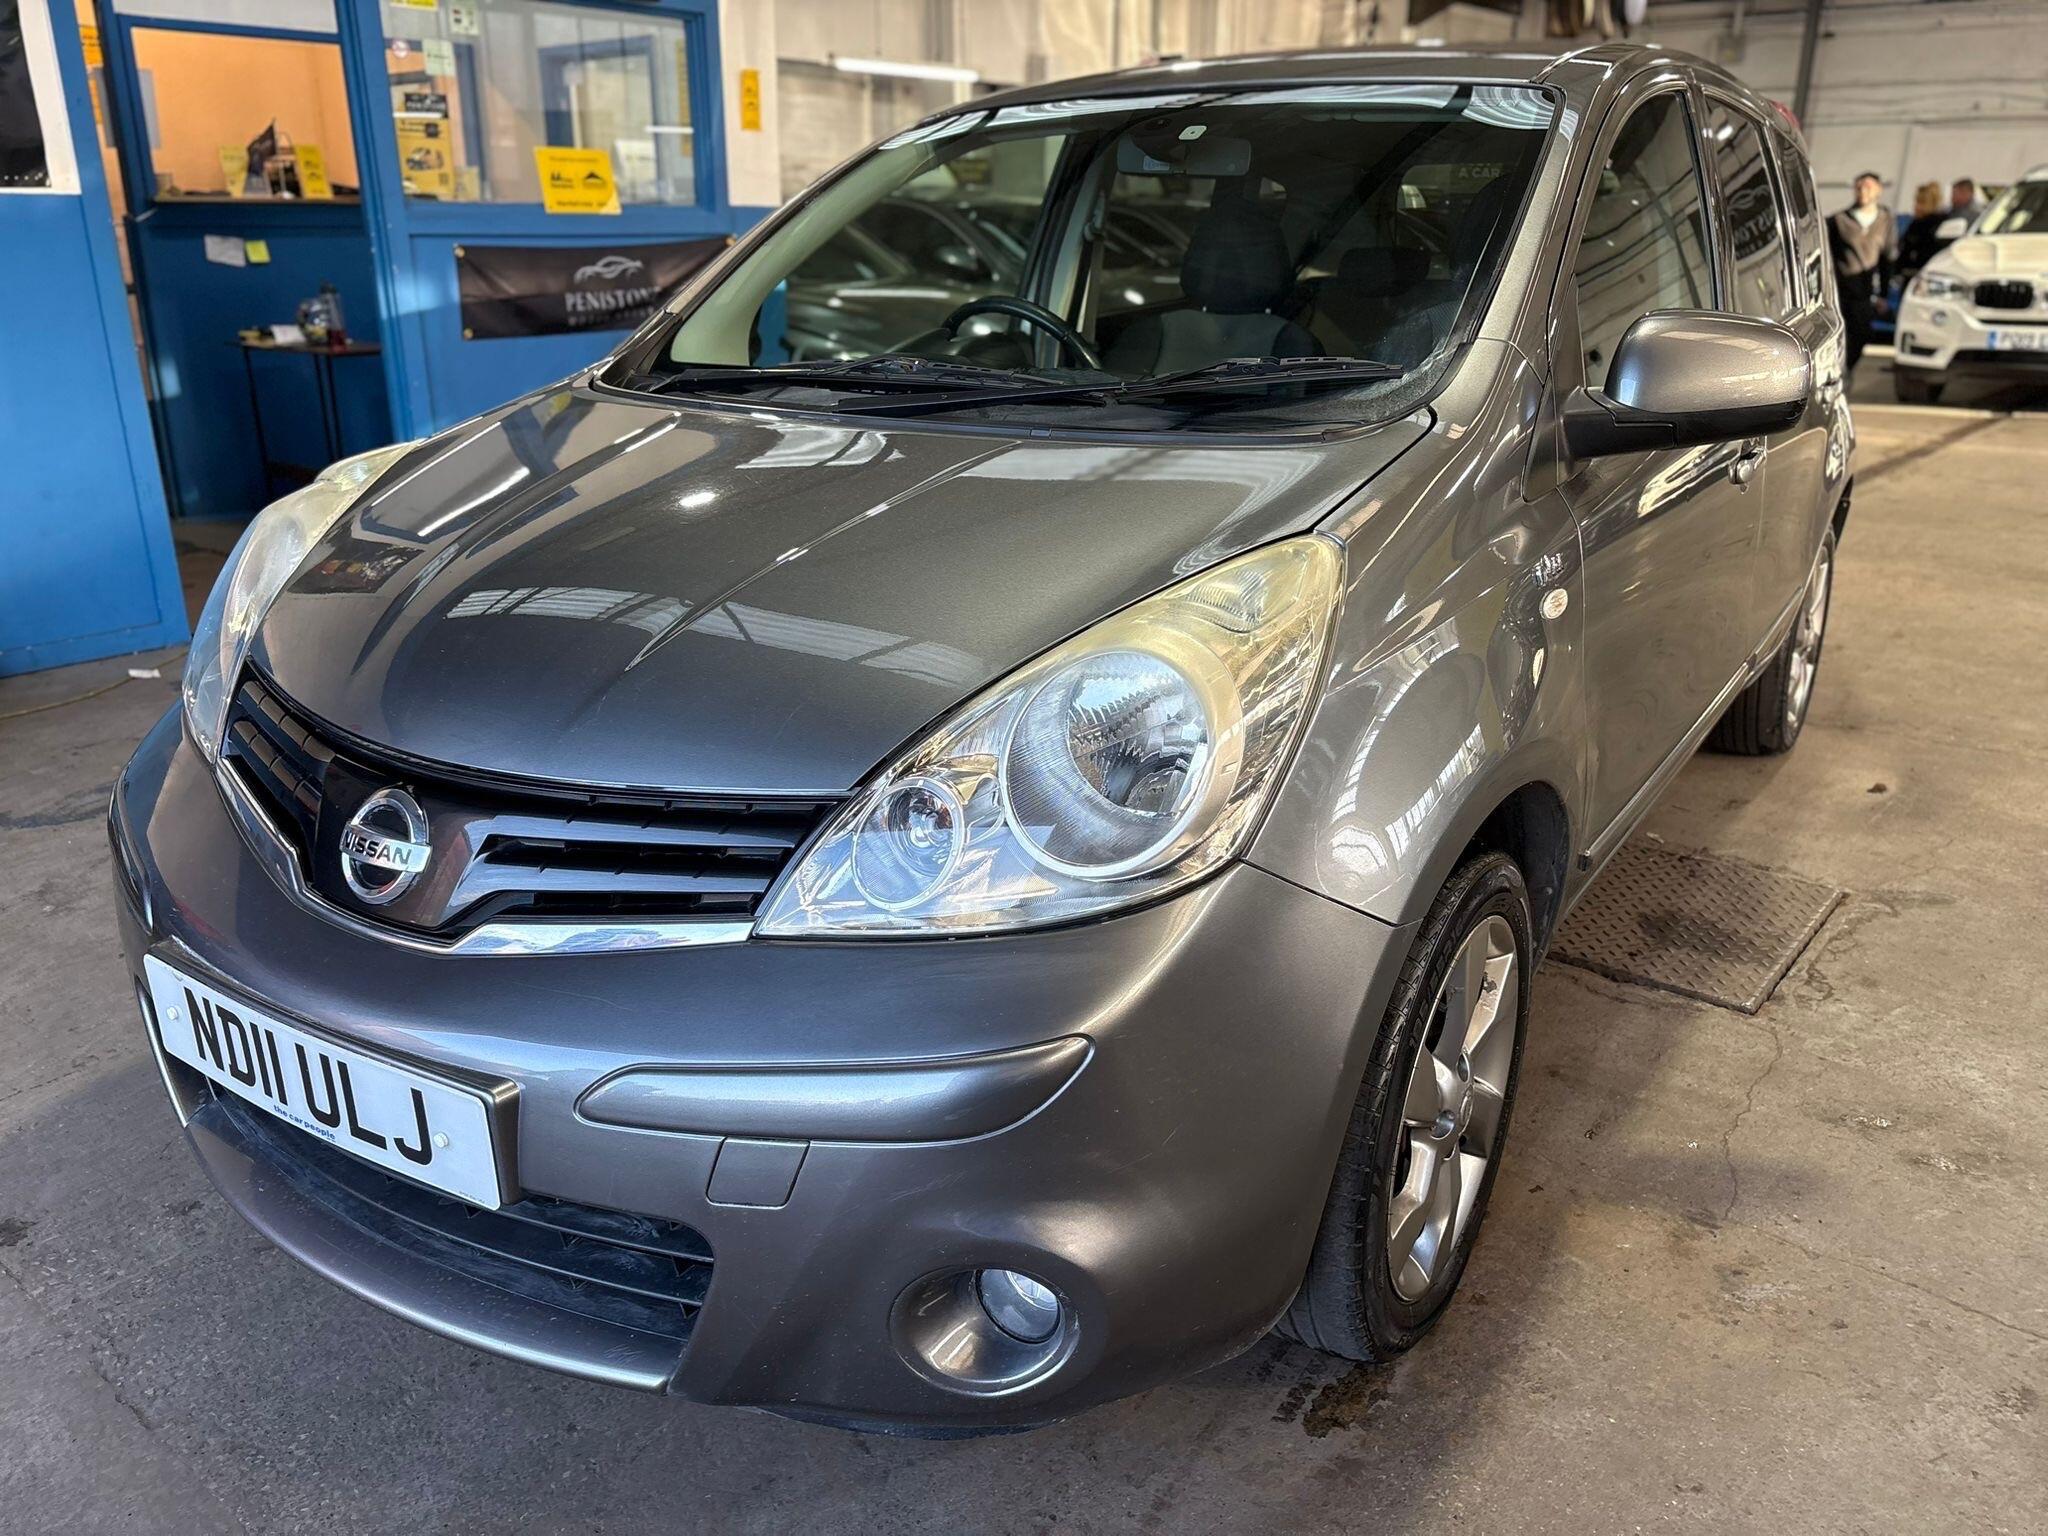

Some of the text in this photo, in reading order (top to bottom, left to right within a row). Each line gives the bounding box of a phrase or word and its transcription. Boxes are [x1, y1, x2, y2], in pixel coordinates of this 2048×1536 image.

[342, 829, 411, 865] NISSAN
[183, 986, 434, 1166] ND11 ULJ
[273, 1105, 288, 1118] the
